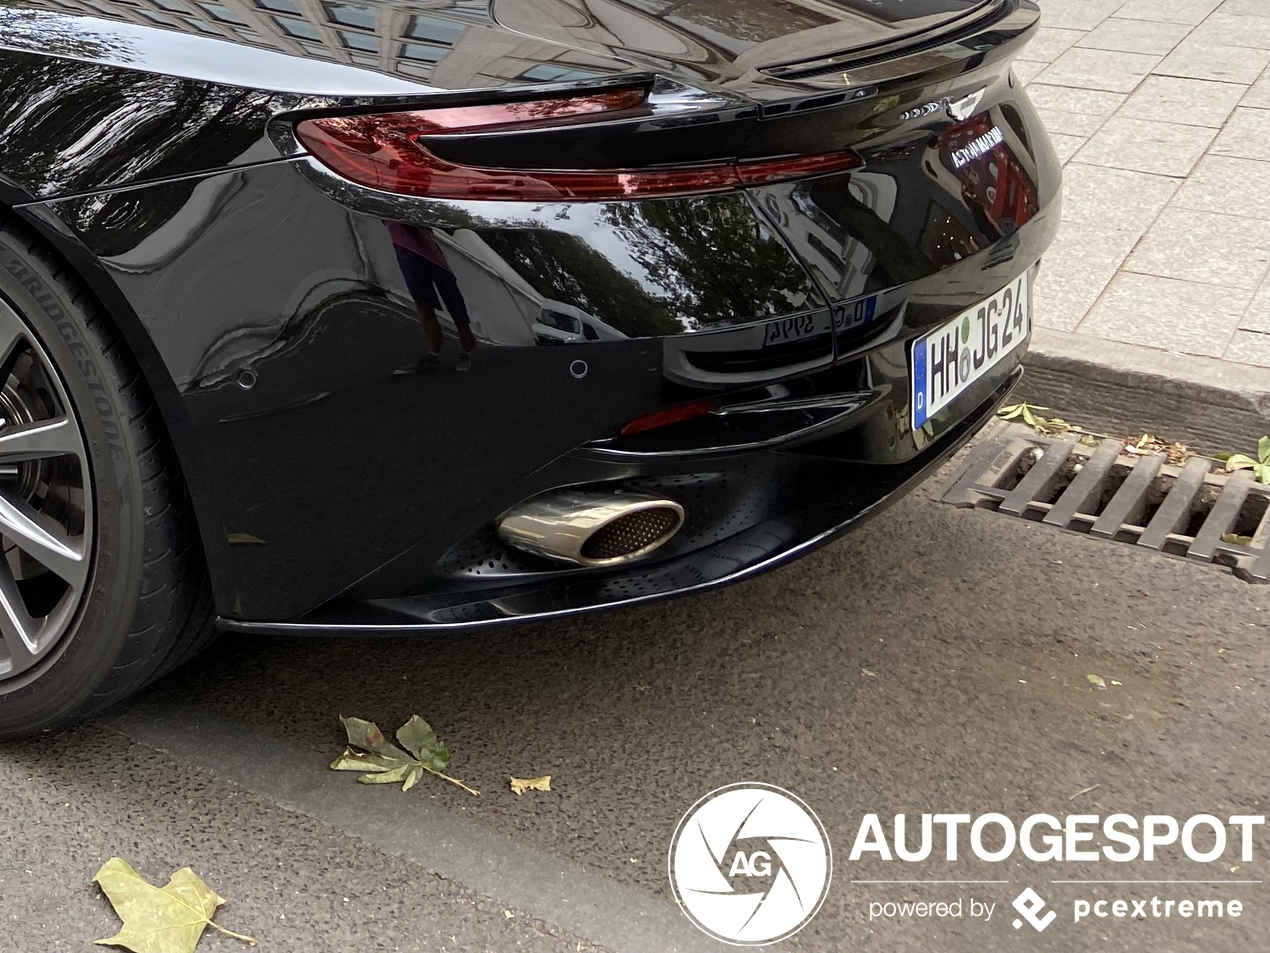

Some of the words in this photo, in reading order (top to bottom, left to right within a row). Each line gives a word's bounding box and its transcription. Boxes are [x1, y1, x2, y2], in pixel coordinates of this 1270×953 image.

[4, 259, 124, 467] BRIDGESTONE
[917, 392, 924, 410] D
[930, 325, 959, 406] HH
[973, 298, 998, 370] JG
[1001, 278, 1024, 348] 24
